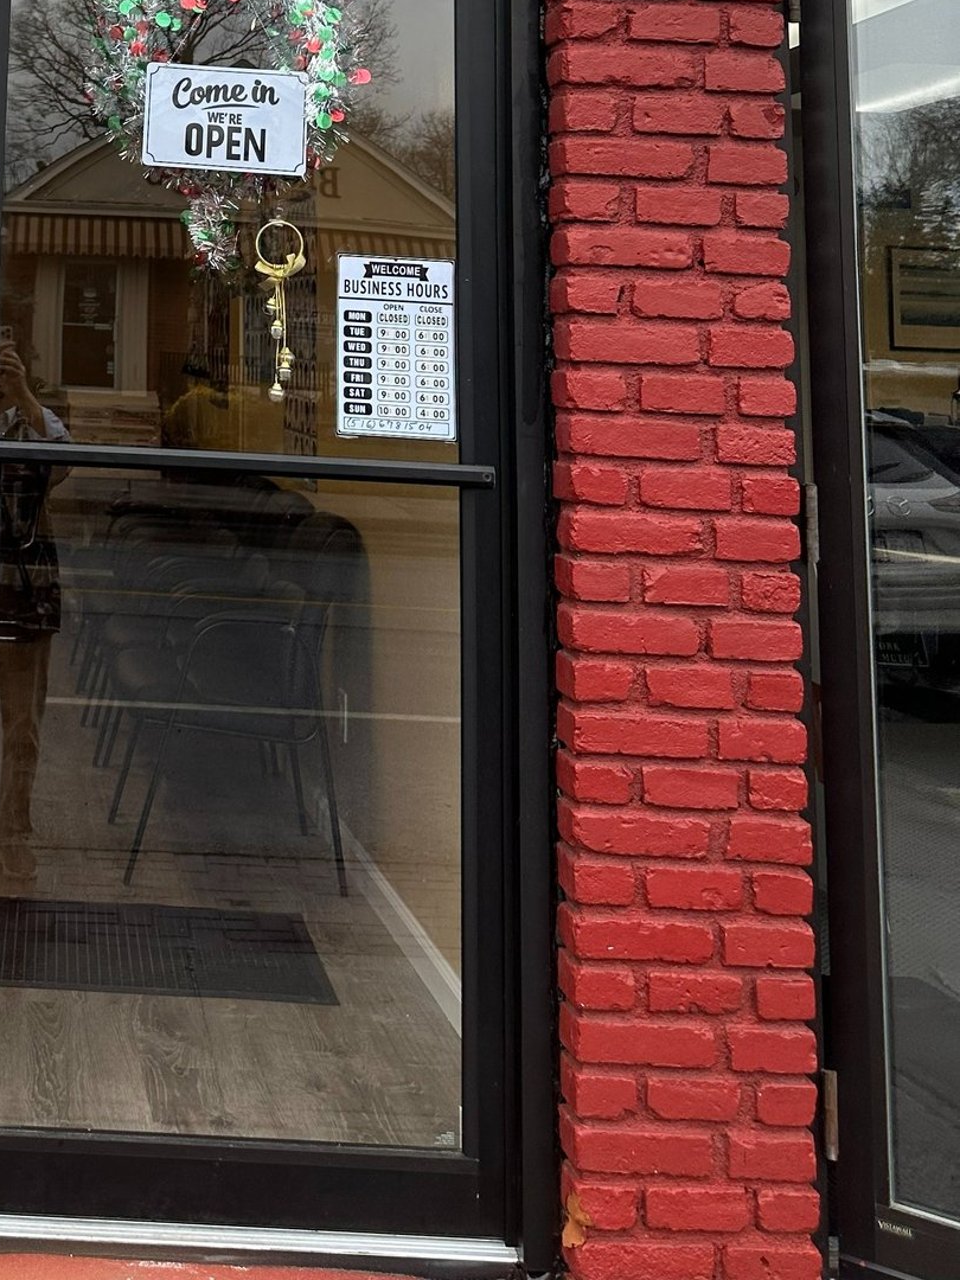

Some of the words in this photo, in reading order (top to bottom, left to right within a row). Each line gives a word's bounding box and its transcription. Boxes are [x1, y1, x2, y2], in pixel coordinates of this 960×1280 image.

[172, 77, 247, 109] Come
[251, 79, 280, 106] in
[207, 111, 243, 125] WE'RE
[184, 123, 267, 163] OPEN
[371, 263, 421, 276] WELCOME
[344, 279, 402, 296] BUSINESS
[407, 283, 449, 299] HOURS
[383, 303, 404, 311] OPEN
[419, 305, 443, 314] CLOSE
[348, 311, 366, 321] MON
[379, 313, 409, 323] CLOSED
[417, 316, 447, 326] CLOSED
[349, 327, 365, 337] TUE
[348, 342, 366, 351] WED
[349, 357, 365, 366] THU
[350, 373, 364, 382] FRI
[349, 388, 365, 397] SAT
[349, 404, 366, 414] SUN
